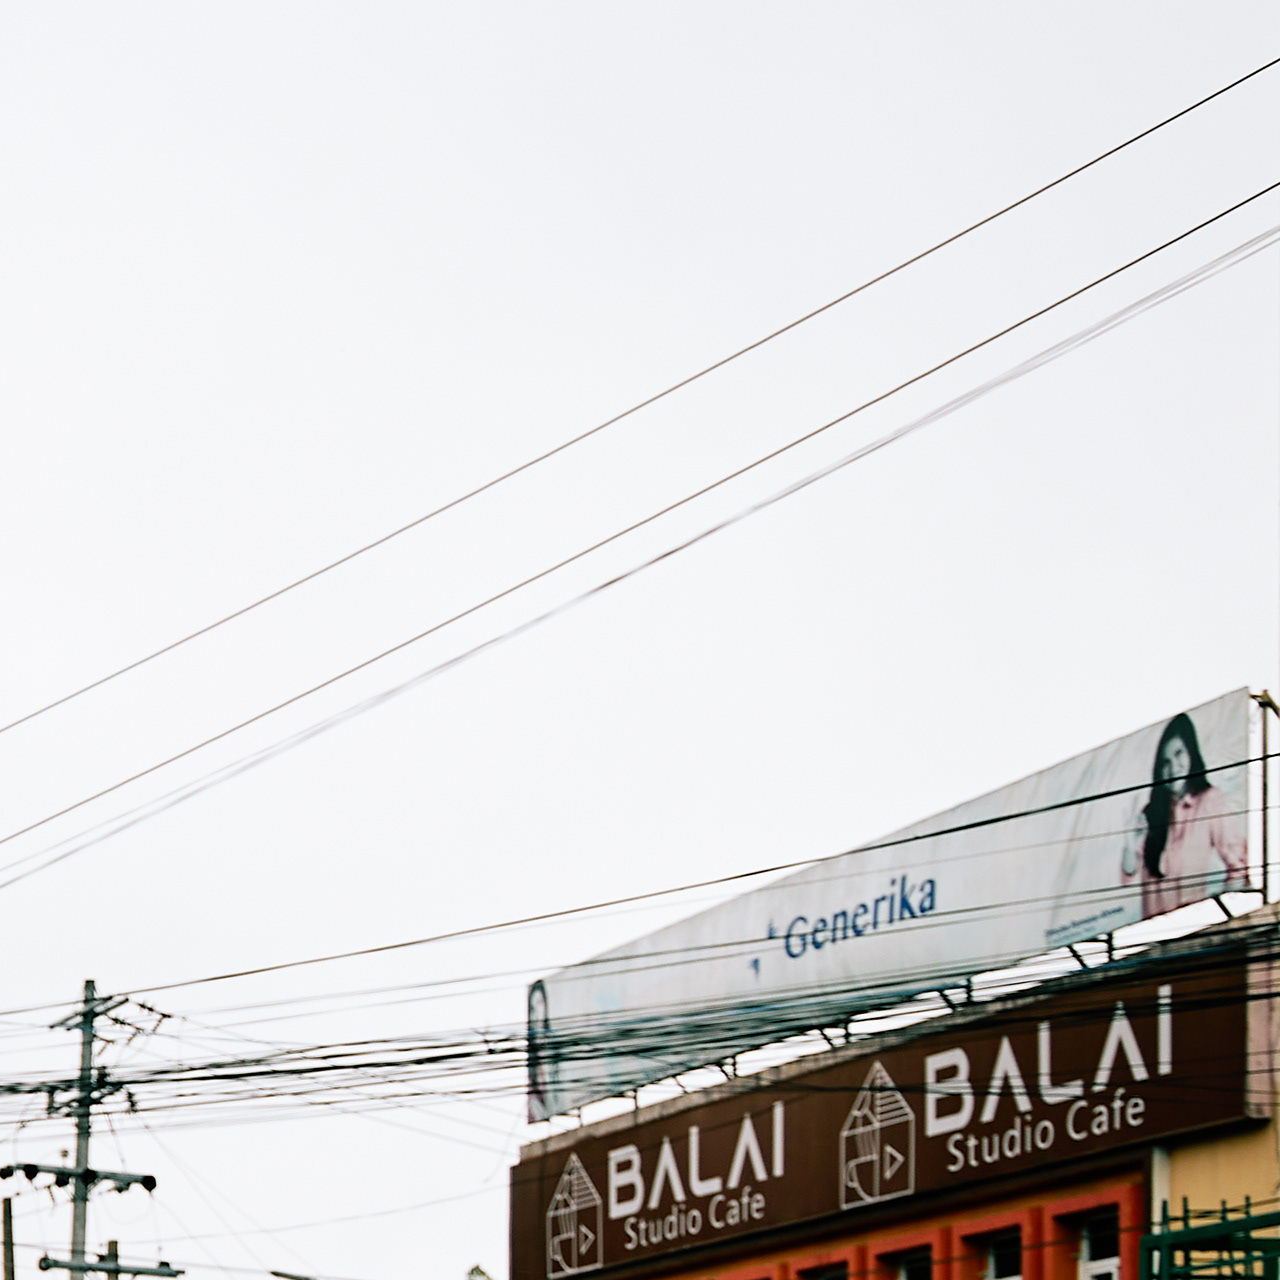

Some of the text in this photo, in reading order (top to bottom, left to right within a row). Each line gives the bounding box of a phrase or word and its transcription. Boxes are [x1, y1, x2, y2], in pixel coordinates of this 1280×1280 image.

[784, 873, 936, 959] Generika
[924, 983, 1173, 1139] BALAI
[607, 1100, 785, 1220] BALAI
[945, 1087, 1146, 1172] Studio Cafe
[624, 1185, 766, 1250] Studio Cafe
